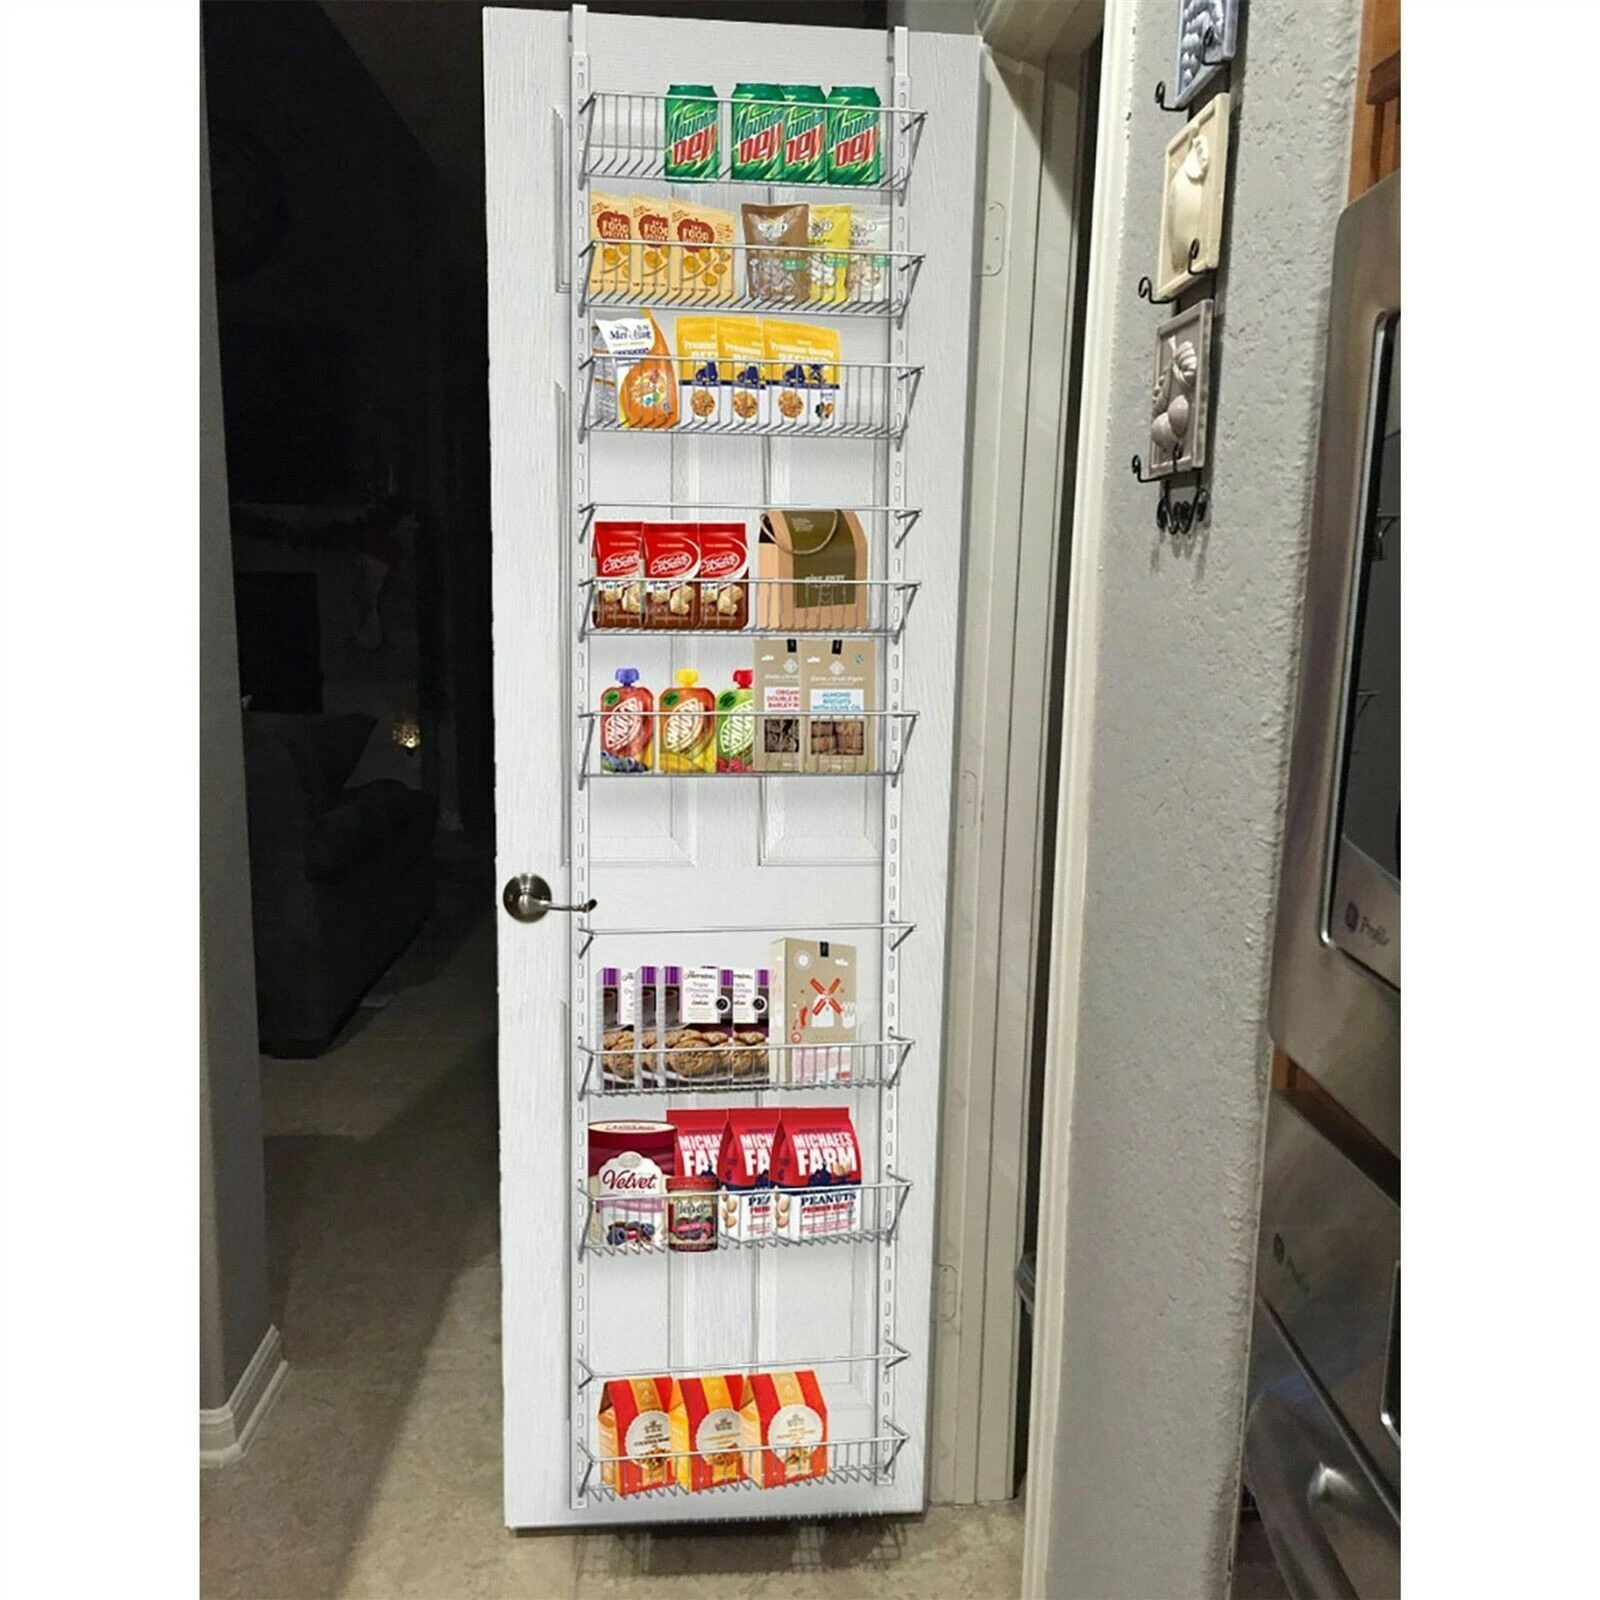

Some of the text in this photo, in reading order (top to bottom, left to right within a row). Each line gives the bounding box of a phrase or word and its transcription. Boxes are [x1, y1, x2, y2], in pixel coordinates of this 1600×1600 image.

[796, 1147, 858, 1177] FARM
[602, 1169, 658, 1190] Velvet
[800, 1191, 857, 1206] PEANUTS
